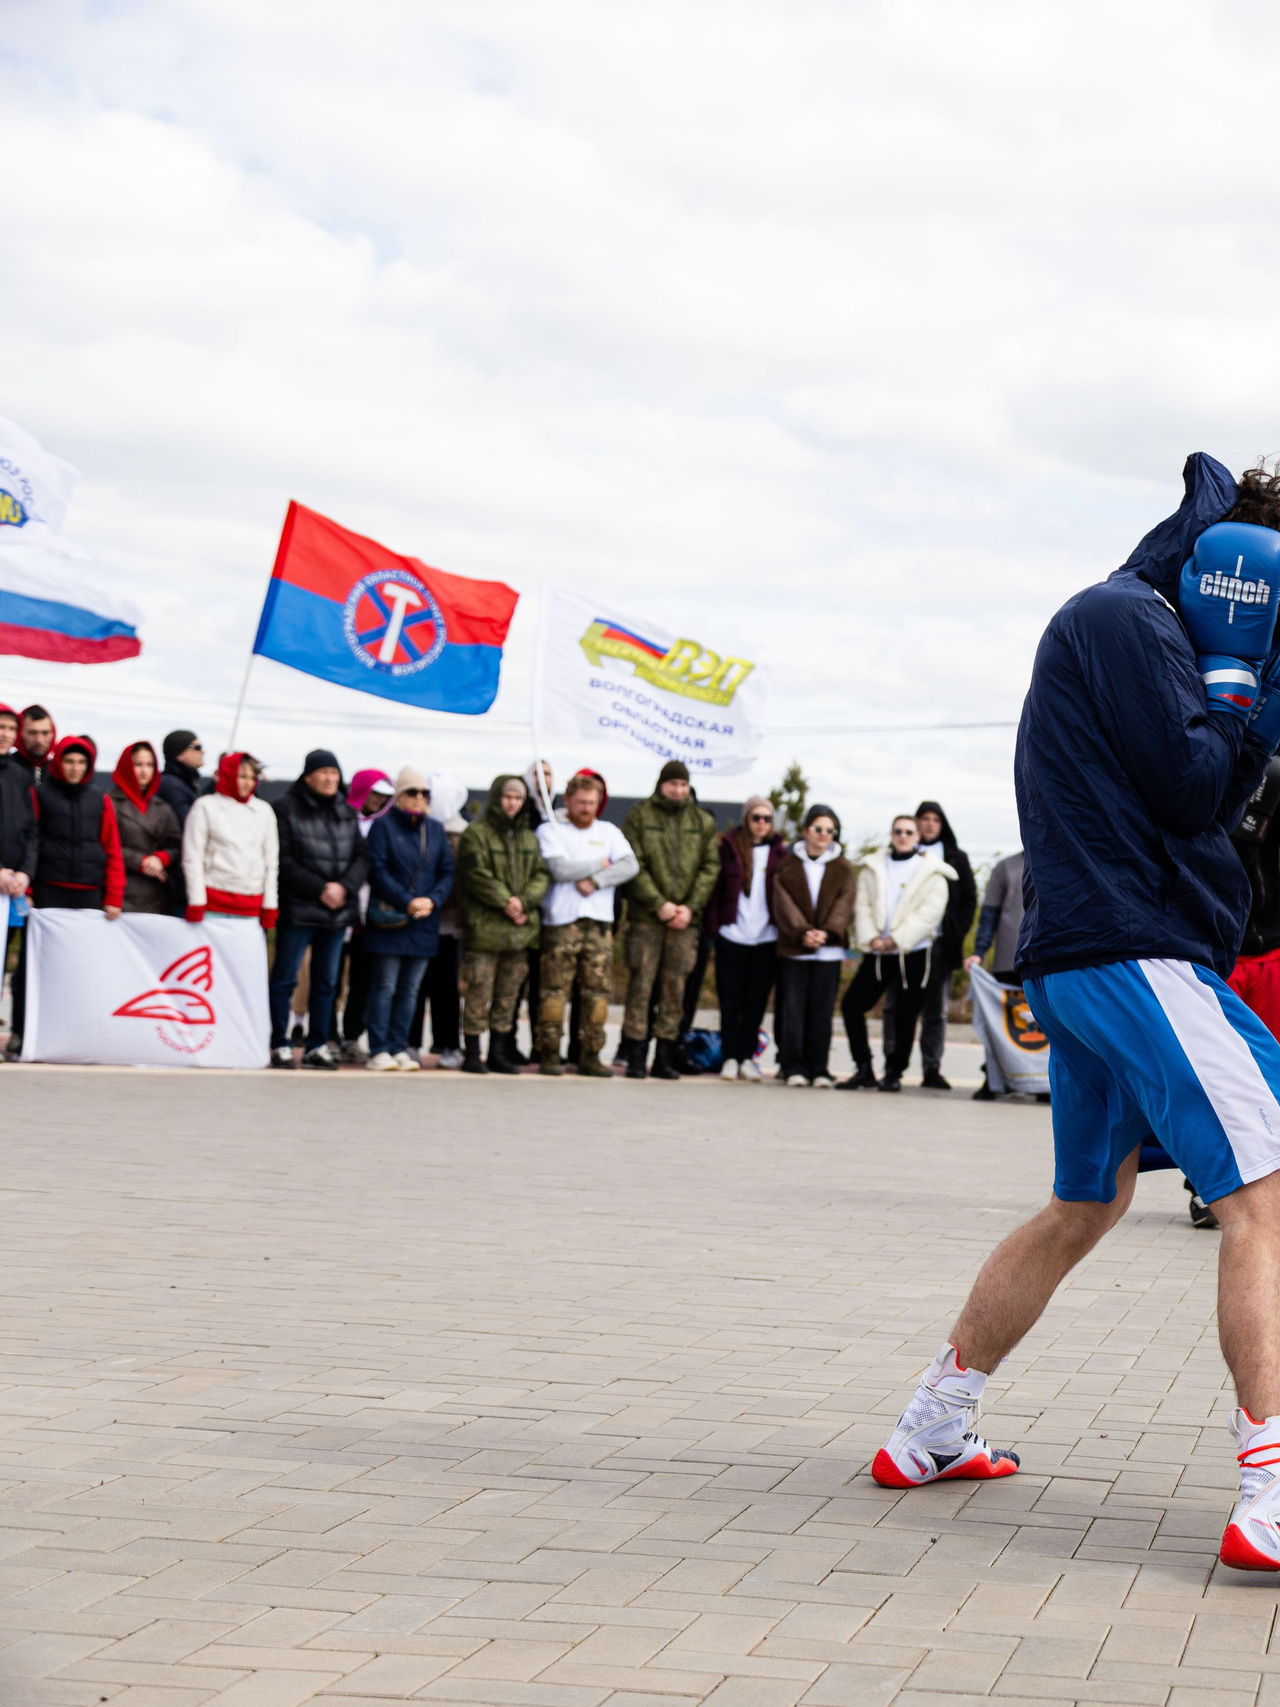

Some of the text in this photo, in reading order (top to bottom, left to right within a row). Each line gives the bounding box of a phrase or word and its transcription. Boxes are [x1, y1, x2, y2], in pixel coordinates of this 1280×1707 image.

[1199, 570, 1271, 606] clinch
[659, 637, 756, 693] ВЭП
[588, 677, 734, 737] ВОЛГОГРАДСКАЯ
